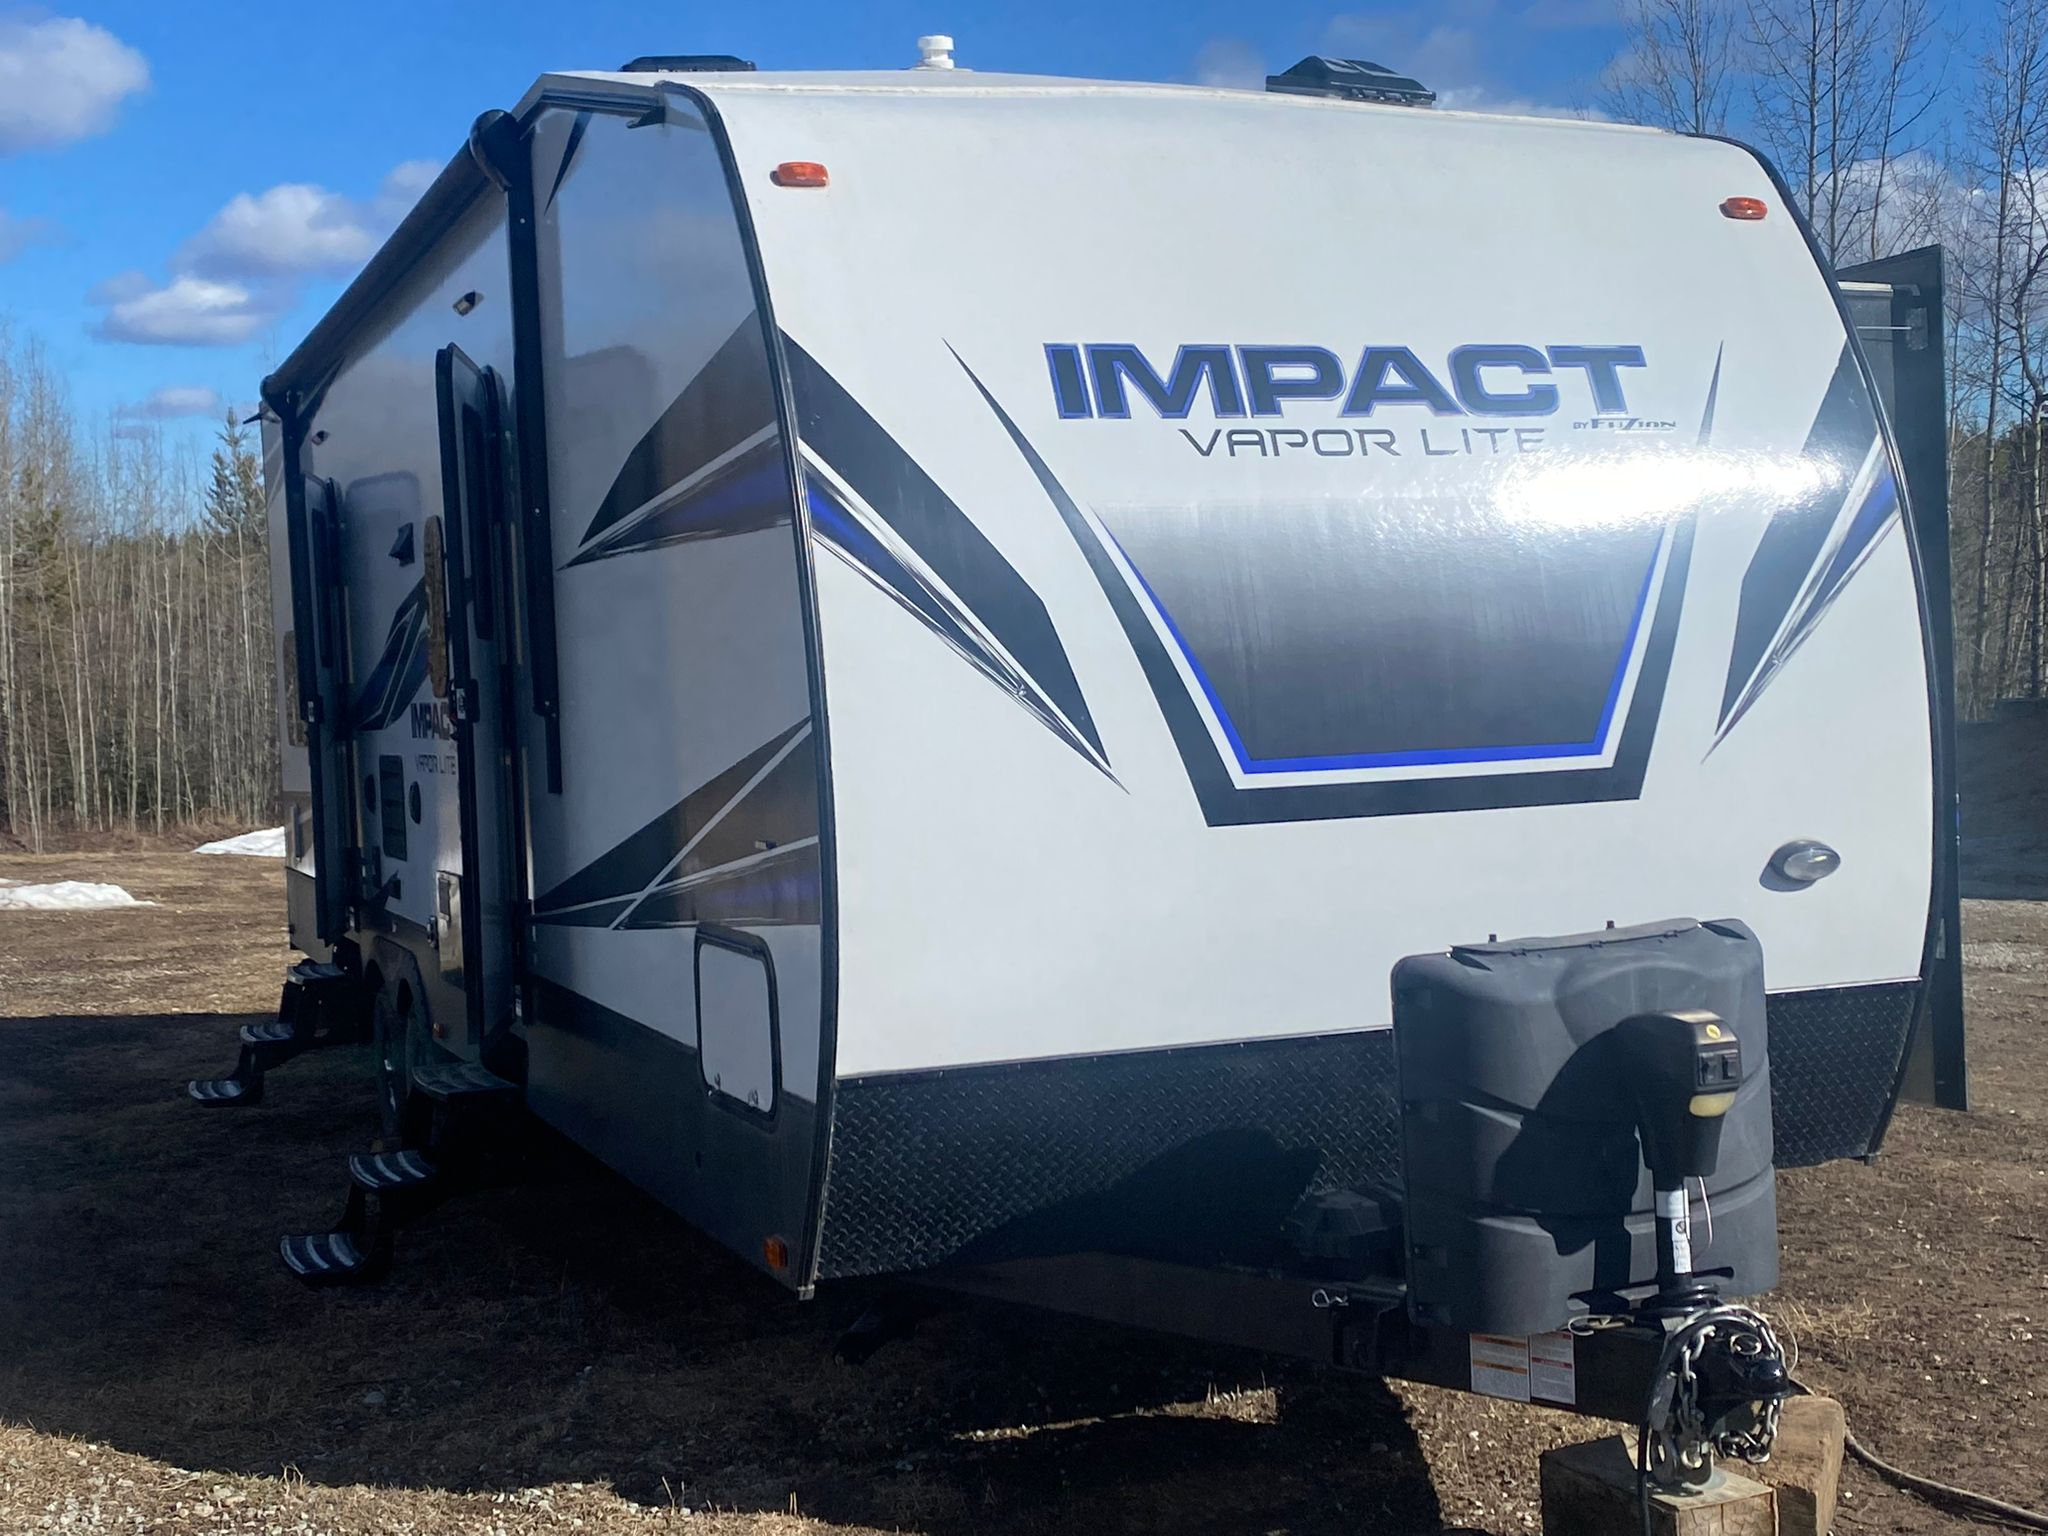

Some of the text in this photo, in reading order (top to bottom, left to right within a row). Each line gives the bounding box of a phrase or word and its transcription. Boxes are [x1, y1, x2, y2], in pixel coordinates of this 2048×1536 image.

[1042, 342, 1648, 420] IMPACT
[1177, 427, 1545, 457] VAPOR LITE
[1573, 421, 1588, 429] BY
[410, 702, 451, 741] IMPAC
